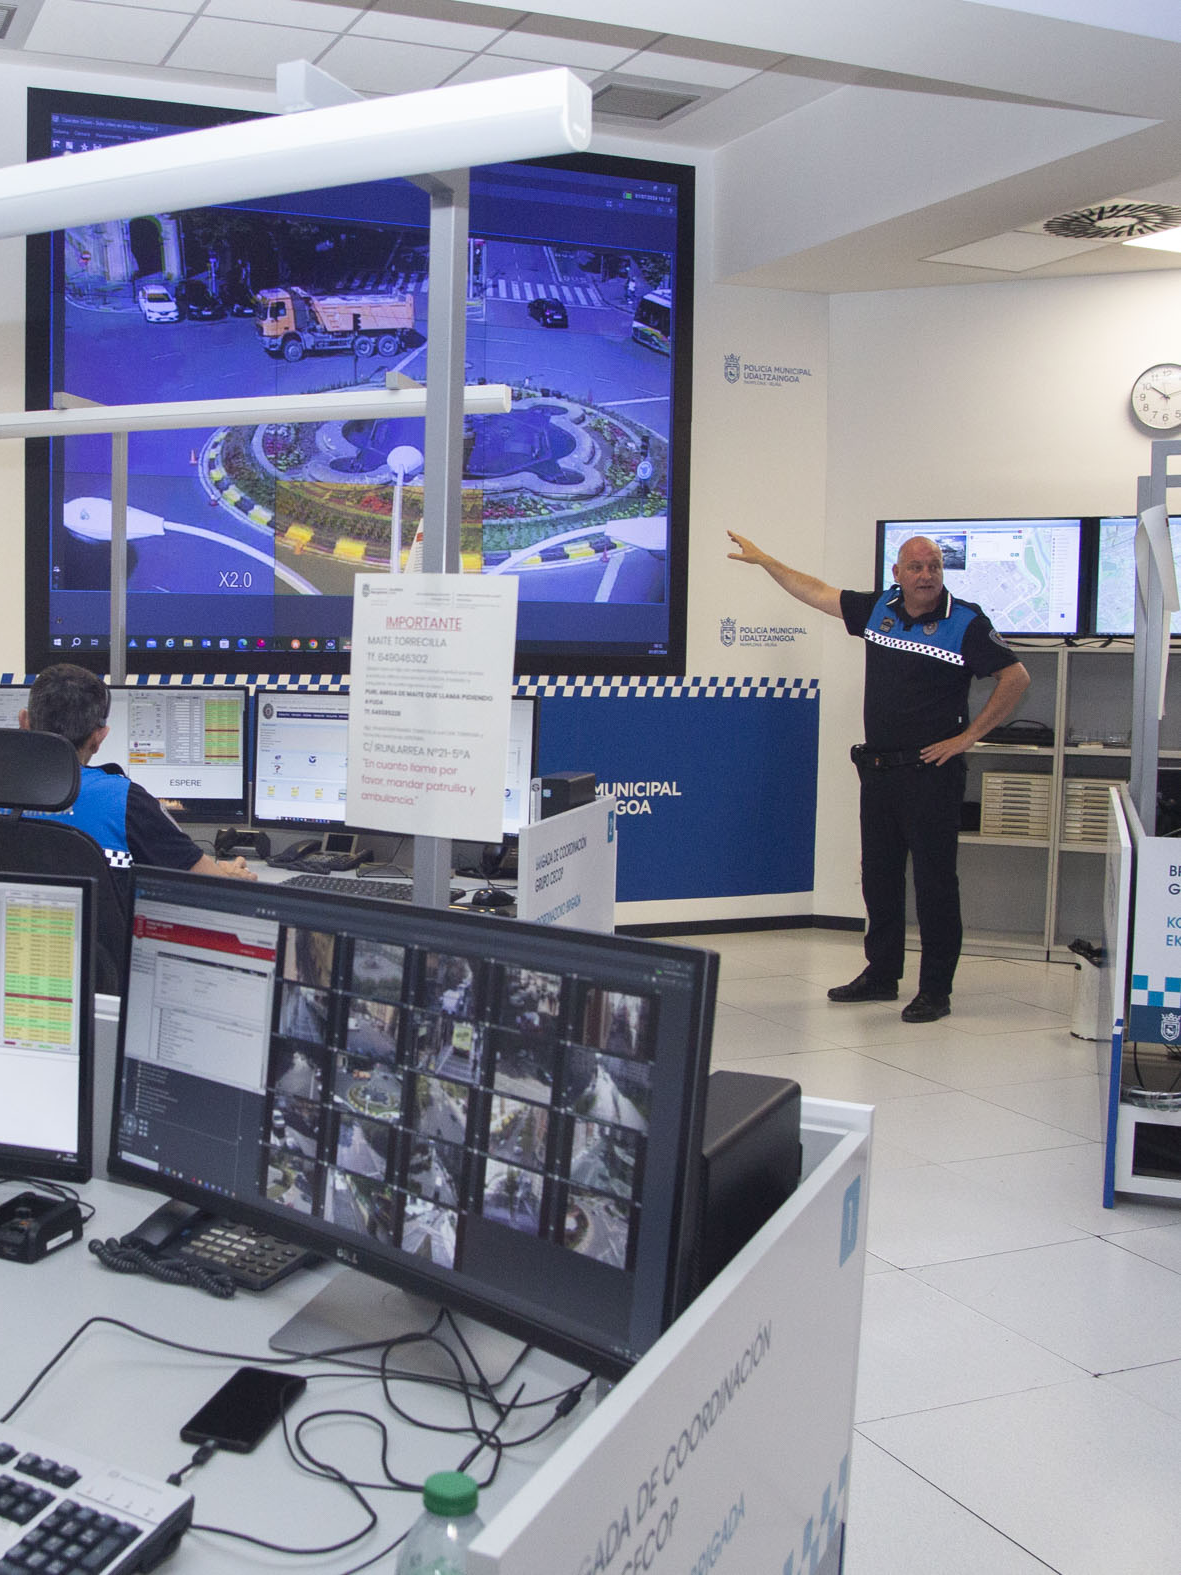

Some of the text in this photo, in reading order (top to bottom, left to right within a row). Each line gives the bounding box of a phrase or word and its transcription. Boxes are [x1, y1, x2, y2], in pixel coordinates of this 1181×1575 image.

[219, 571, 252, 588] X2.0
[386, 616, 462, 631] IMPORTANTE
[367, 636, 447, 648] MAITE TORRECILLA
[376, 761, 408, 772] cuanto
[439, 766, 458, 777] por
[169, 779, 202, 787] ESPERE
[386, 778, 424, 790] mandar
[595, 781, 682, 797] MUNICIPAL
[637, 1464, 660, 1526] DE
[663, 1320, 773, 1487] COORDINACIÓN
